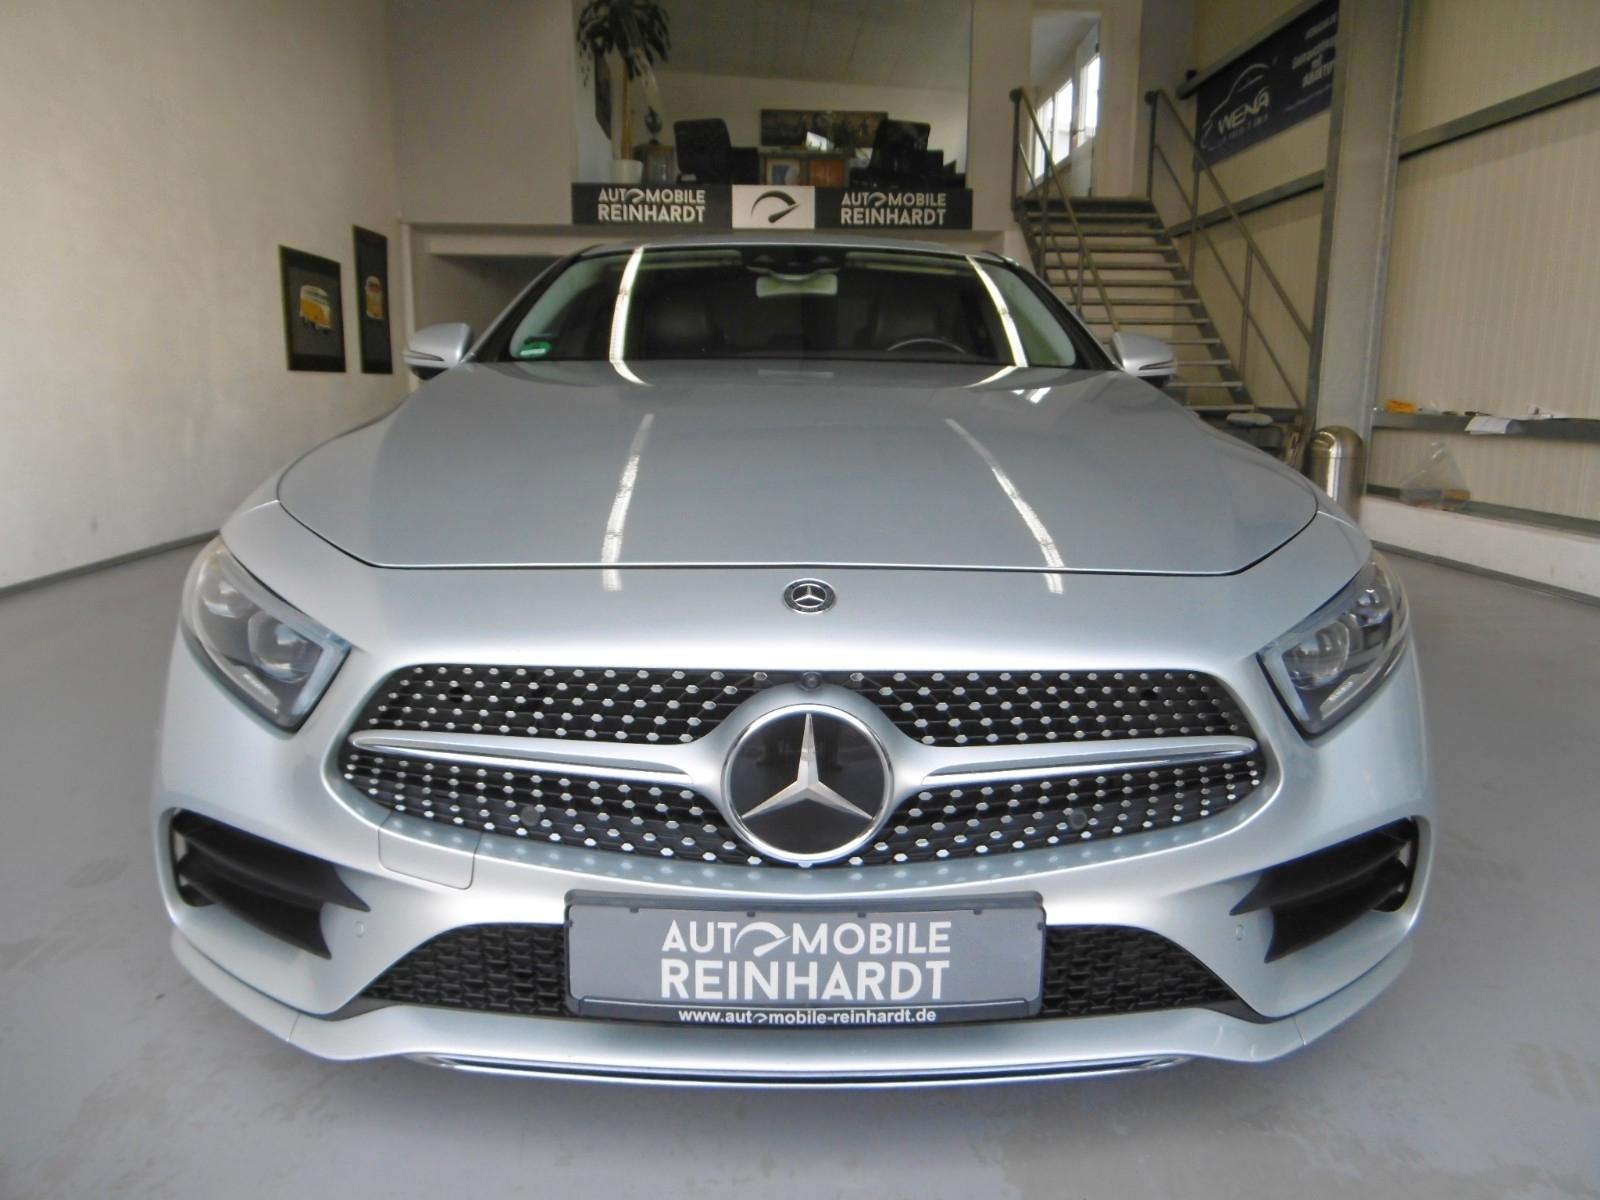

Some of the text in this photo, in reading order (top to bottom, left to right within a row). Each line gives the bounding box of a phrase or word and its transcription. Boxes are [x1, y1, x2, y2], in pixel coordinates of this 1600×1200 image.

[597, 204, 706, 223] REINHARDT
[840, 207, 946, 225] REINHARDT
[660, 959, 951, 1001] REINHARDT
